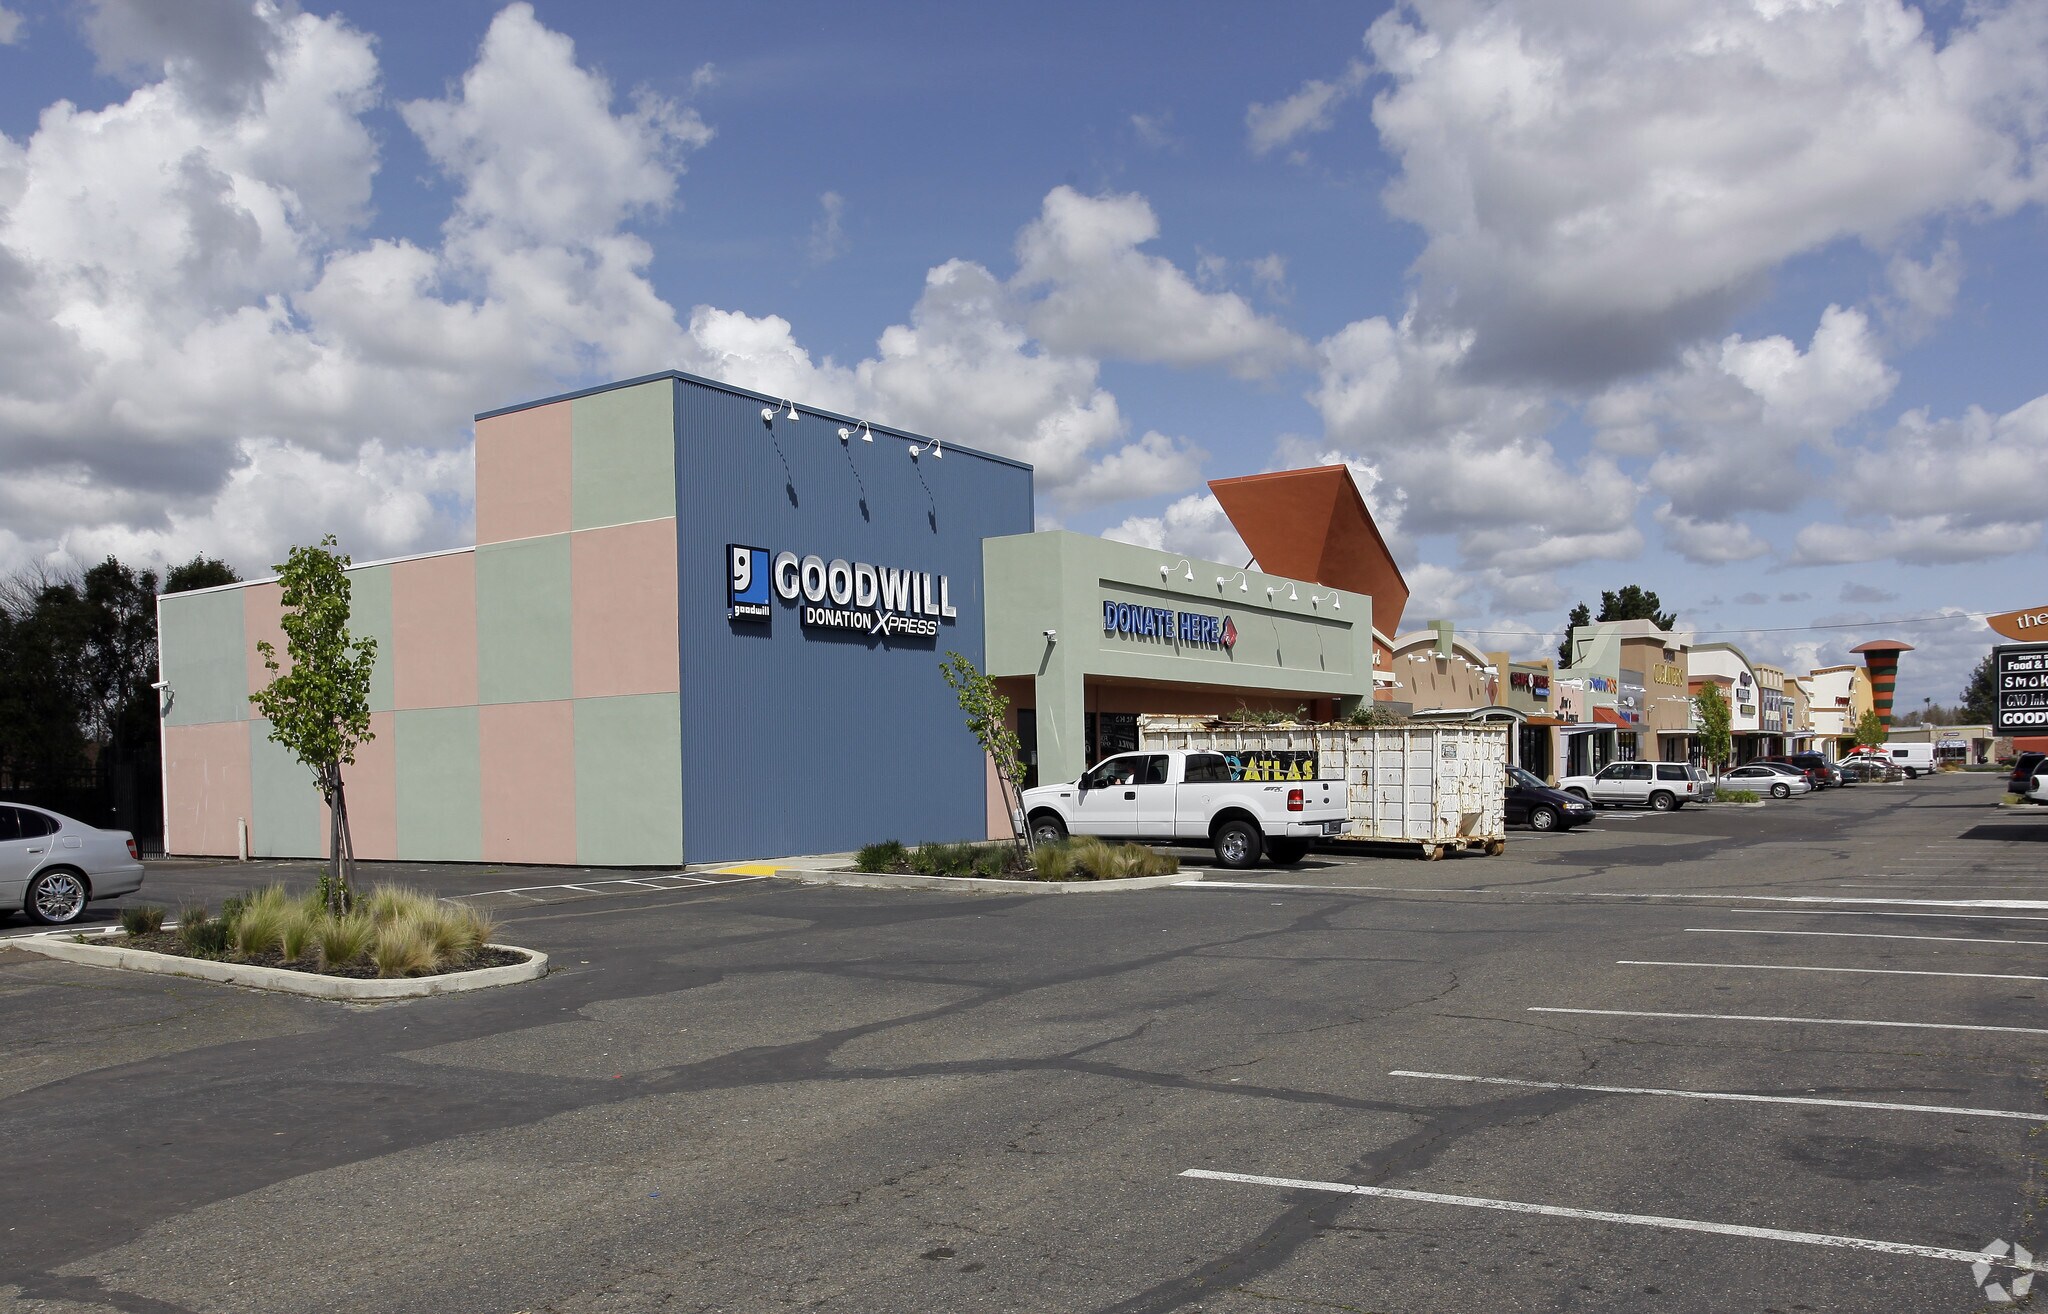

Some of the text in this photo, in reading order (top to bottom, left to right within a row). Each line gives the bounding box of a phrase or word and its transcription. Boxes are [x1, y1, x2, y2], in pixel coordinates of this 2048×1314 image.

[774, 551, 957, 618] GOODWILL
[735, 605, 770, 617] goodwill
[806, 607, 938, 636] DONATION XPRESS
[1103, 600, 1220, 644] DONATE HERE
[2017, 612, 2048, 629] the
[2007, 661, 2033, 671] Food
[2034, 660, 2043, 669] &
[2030, 693, 2045, 706] Ink
[2002, 711, 2048, 725] GOOD
[1243, 756, 1313, 780] ATLAS
